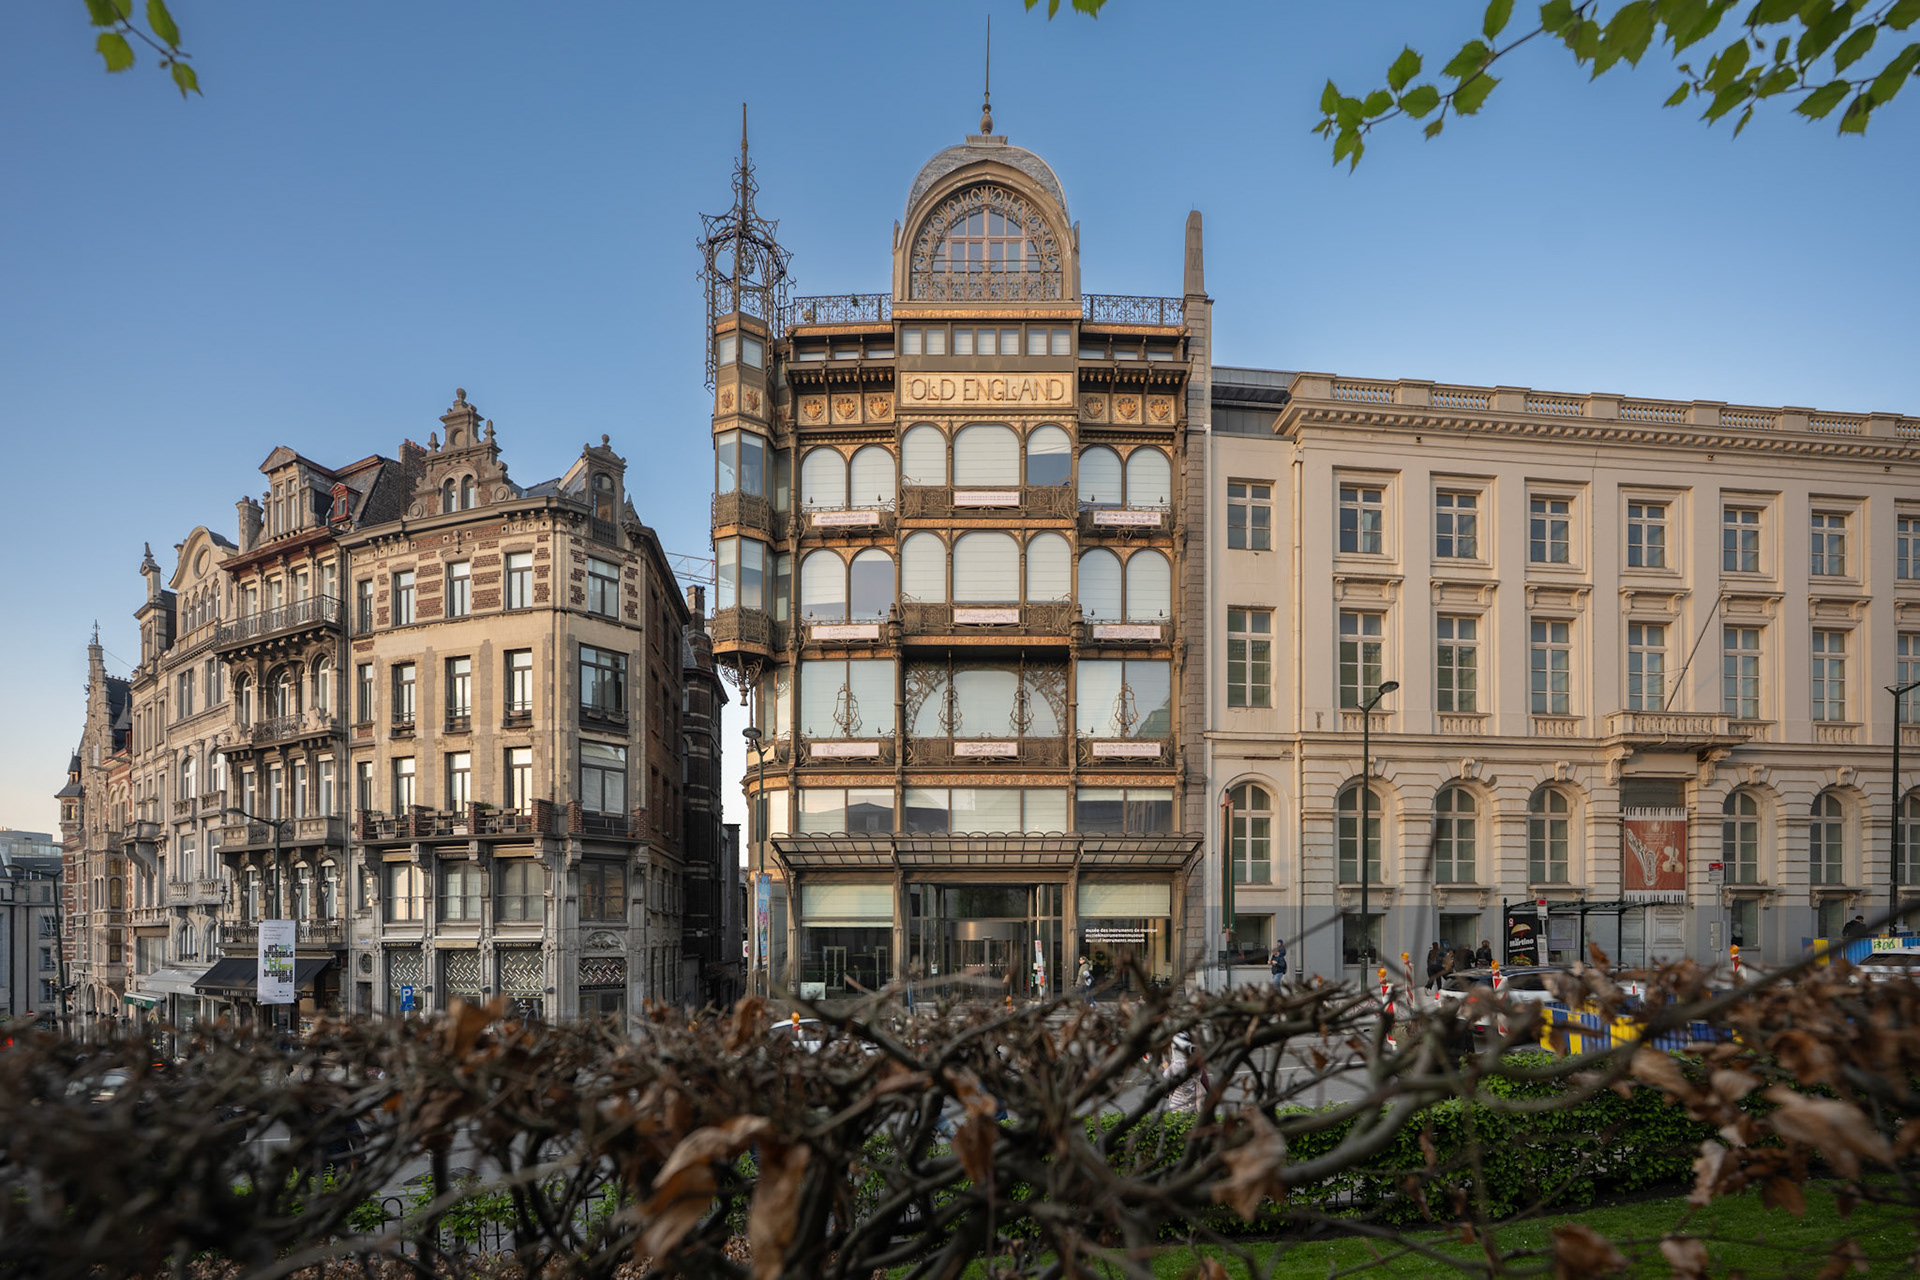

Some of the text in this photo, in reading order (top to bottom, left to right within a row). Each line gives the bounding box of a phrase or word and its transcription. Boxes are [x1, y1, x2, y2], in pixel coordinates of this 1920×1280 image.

[911, 378, 1065, 401] OLD ENGLAND
[268, 943, 279, 951] art
[264, 950, 293, 958] brussels
[264, 969, 293, 977] brussels
[402, 988, 412, 1002] P
